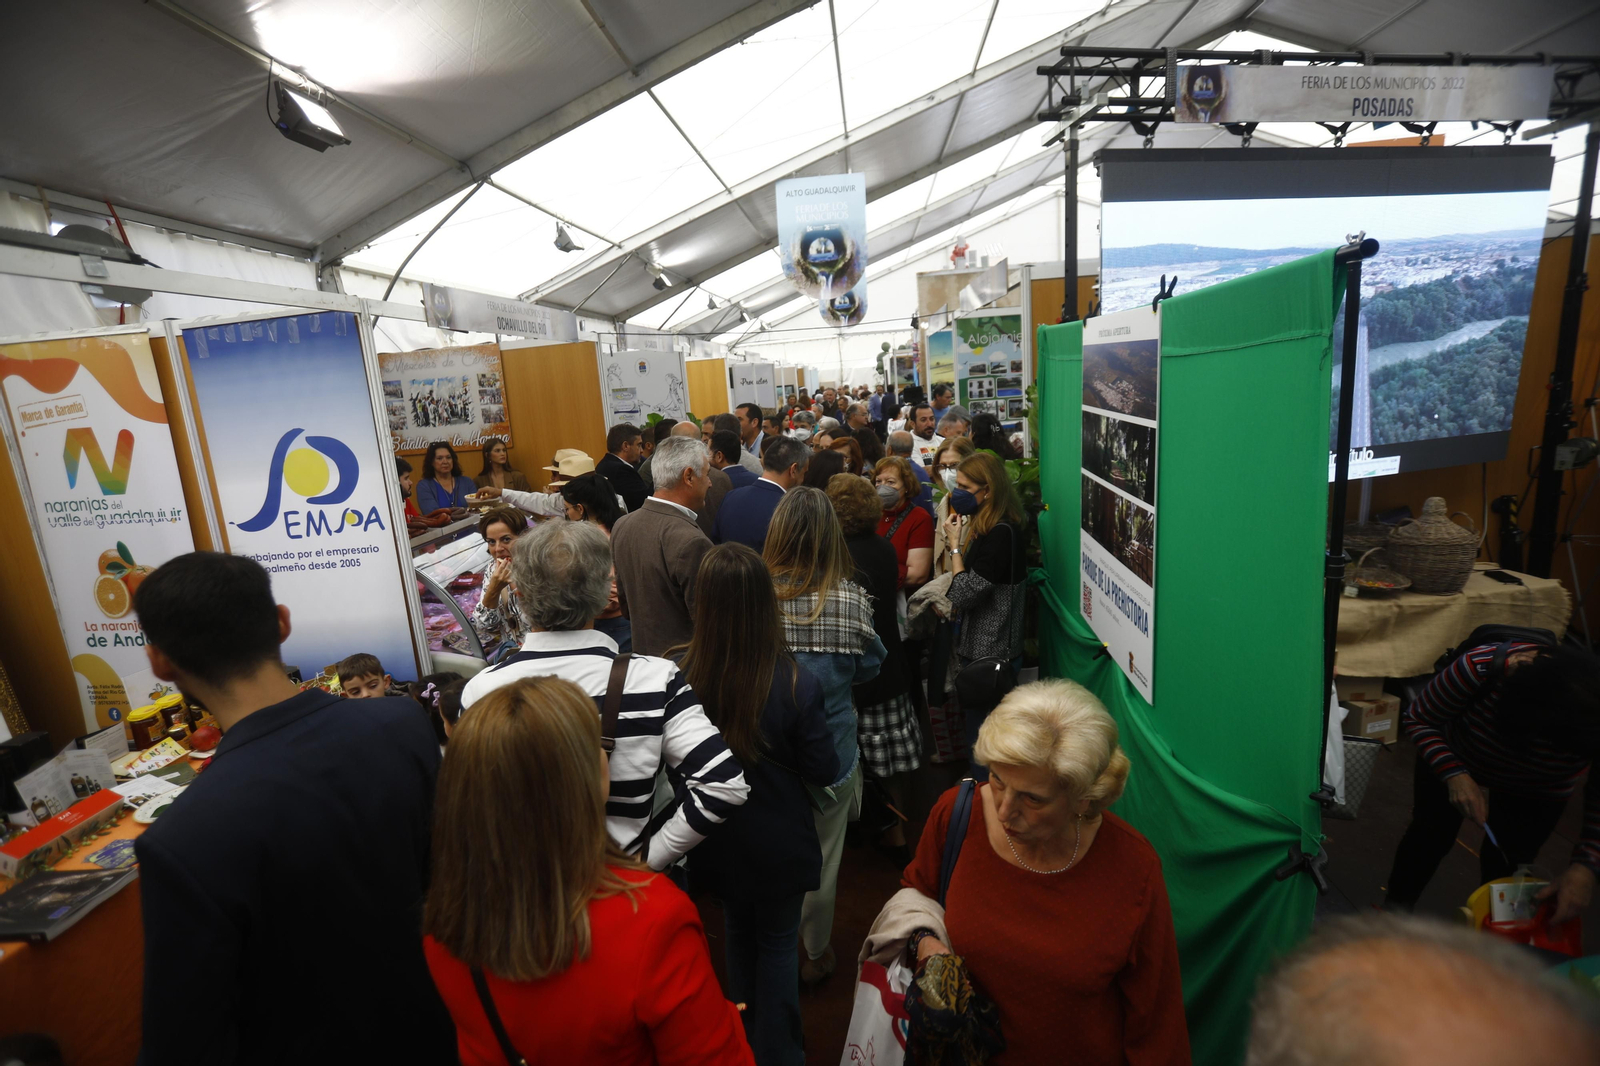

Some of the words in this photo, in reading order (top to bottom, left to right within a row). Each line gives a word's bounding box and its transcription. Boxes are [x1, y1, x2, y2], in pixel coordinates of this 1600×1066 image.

[1301, 76, 1331, 89] FERIA
[1333, 76, 1348, 89] DE
[1351, 76, 1371, 89] LOS
[1373, 76, 1437, 90] MUNICIPIOS
[1441, 77, 1465, 90] 2022
[1352, 97, 1414, 117] POSADAS
[785, 189, 803, 198] ALTO
[804, 184, 857, 196] GUADALQUIVIR
[833, 201, 849, 211] LOS
[496, 315, 528, 333] OCHAVILLO
[528, 320, 539, 334] DEL
[967, 330, 1022, 347] Alojamie
[441, 354, 455, 368] de
[20, 410, 43, 423] Marca
[44, 407, 55, 419] de
[54, 401, 84, 417] Garantía
[452, 433, 463, 447] la
[44, 497, 109, 514] naranjas
[110, 500, 123, 510] del
[47, 513, 81, 528] valle
[83, 515, 95, 527] del
[297, 551, 313, 560] por
[315, 548, 324, 557] el
[326, 544, 379, 558] empresario
[308, 560, 337, 571] desde
[340, 558, 361, 568] 2005
[1082, 551, 1098, 584] PARQUE
[1098, 567, 1104, 591] DE
[1104, 573, 1111, 599] LA
[1111, 580, 1149, 638] PREHISTORIA
[84, 621, 98, 632] La
[86, 633, 108, 648] de
[113, 632, 151, 647] And
